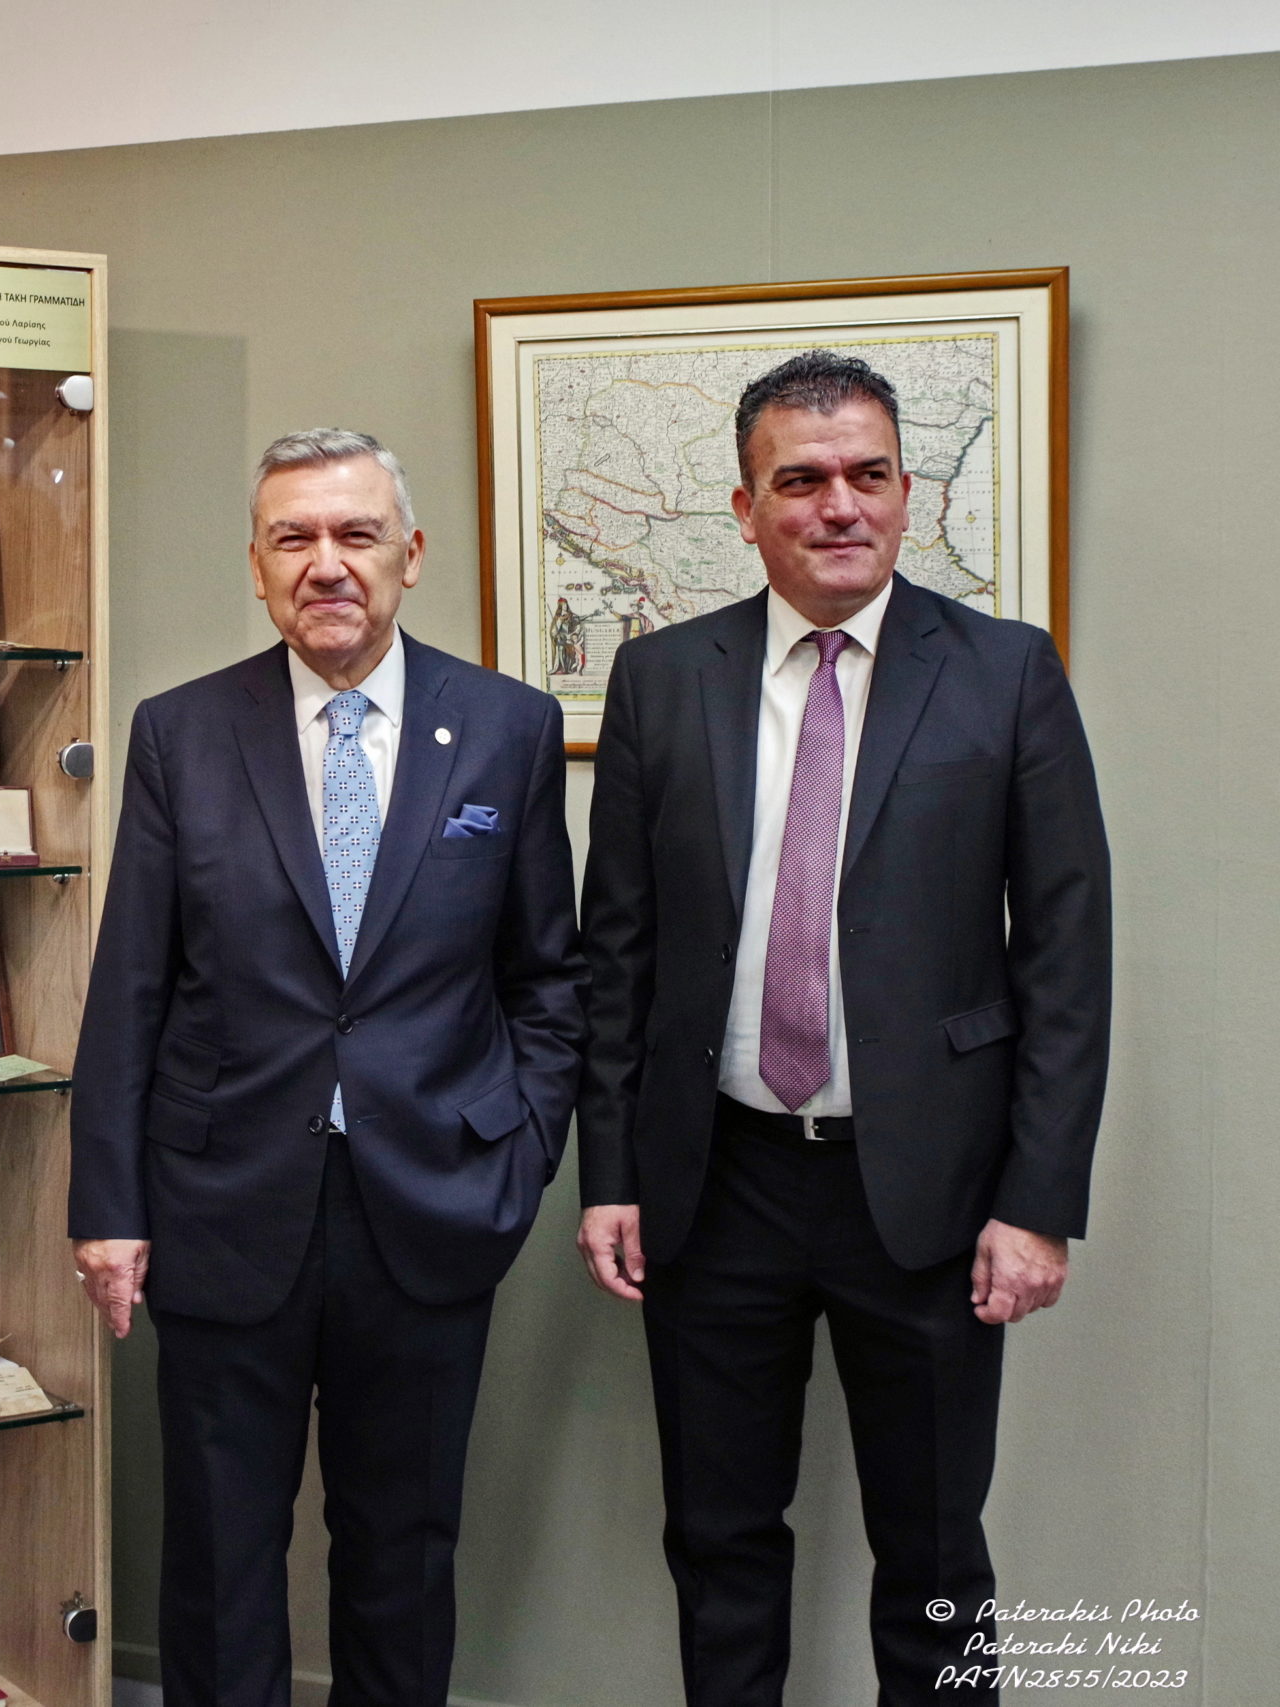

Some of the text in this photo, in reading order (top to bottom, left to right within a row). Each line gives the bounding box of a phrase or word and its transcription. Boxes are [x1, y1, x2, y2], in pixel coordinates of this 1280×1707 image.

[5, 293, 27, 303] ΤΑΚΗ
[29, 294, 85, 307] ΓΡΑΜΜΑΤΙΔΗ
[12, 320, 46, 330] Λαρίσης
[14, 336, 51, 347] Γεωργίας
